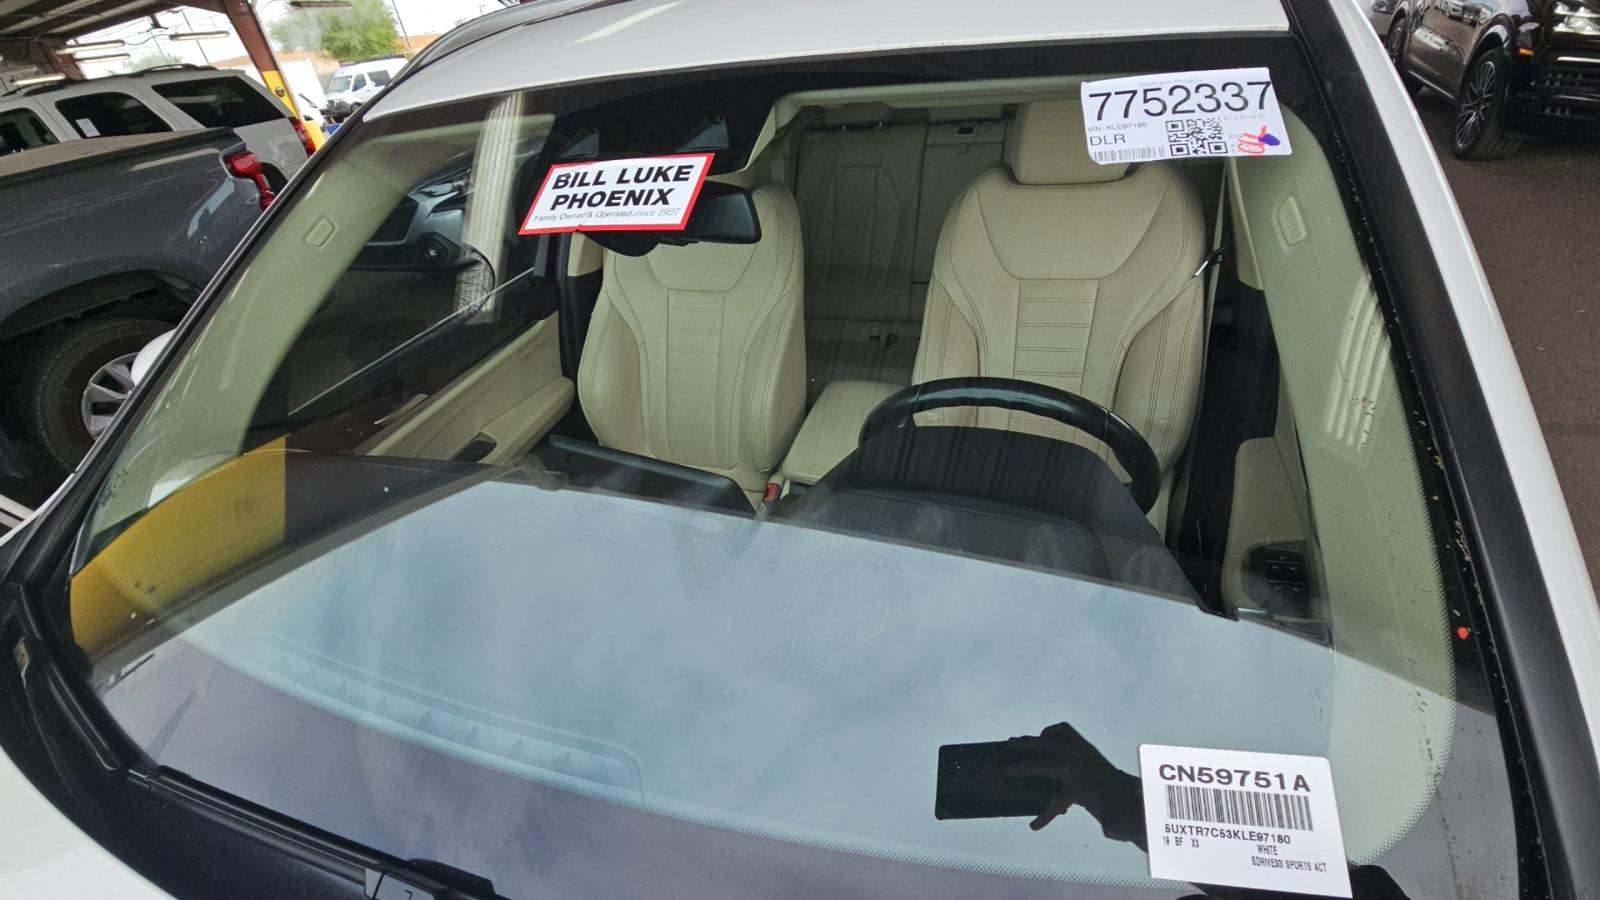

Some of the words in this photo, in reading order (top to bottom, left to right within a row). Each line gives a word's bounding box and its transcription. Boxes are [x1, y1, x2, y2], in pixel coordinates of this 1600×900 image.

[1088, 81, 1271, 121] 7752337
[1089, 133, 1126, 146] DLR
[552, 169, 606, 190] BILL
[616, 164, 694, 185] LUKE
[550, 188, 675, 210] PHOENIX
[534, 214, 558, 223] Family
[586, 210, 593, 218] &
[595, 209, 633, 219] Operated
[657, 207, 681, 217] 1927
[1158, 764, 1311, 792] CN59751A
[1164, 824, 1291, 845] 5UXTR7C53KLE97180
[1190, 838, 1199, 848] X3
[1256, 844, 1278, 856] WHITE
[1285, 859, 1312, 872] SPORTS
[1314, 862, 1327, 873] ACT
